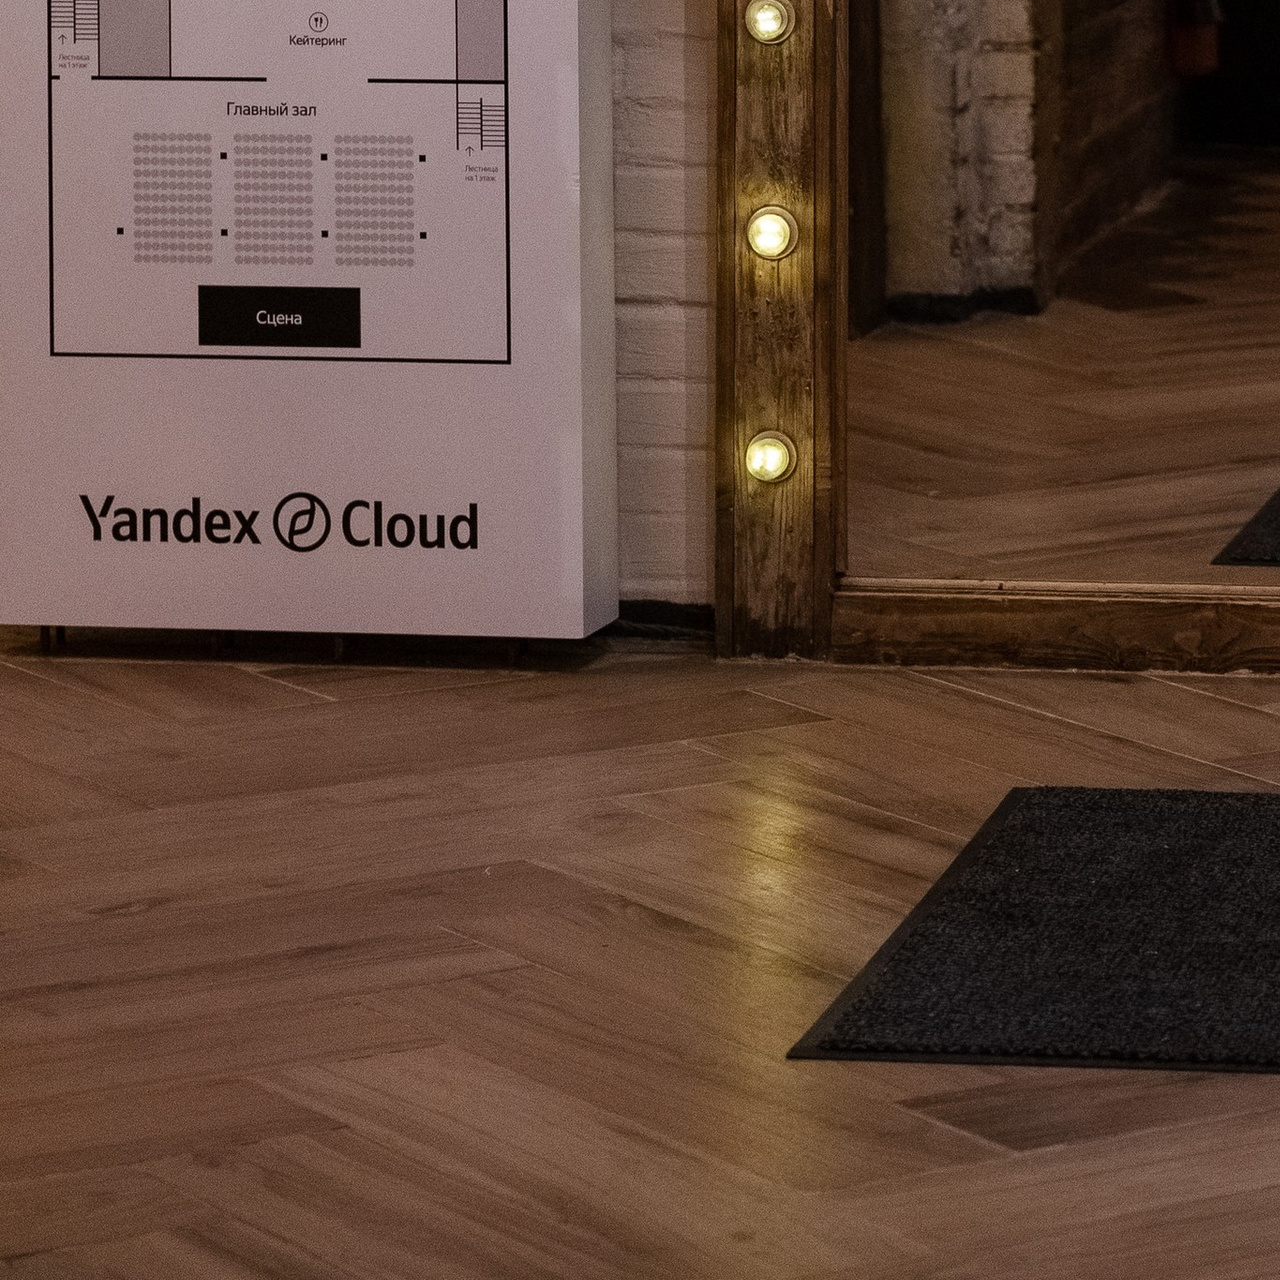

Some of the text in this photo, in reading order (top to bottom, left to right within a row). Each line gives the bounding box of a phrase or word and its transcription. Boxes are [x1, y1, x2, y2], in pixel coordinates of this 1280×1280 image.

[288, 35, 347, 48] Кейтеринг
[226, 101, 317, 117] Главный зал
[255, 309, 303, 327] Сцена
[79, 494, 478, 550] Yandex Cloud
